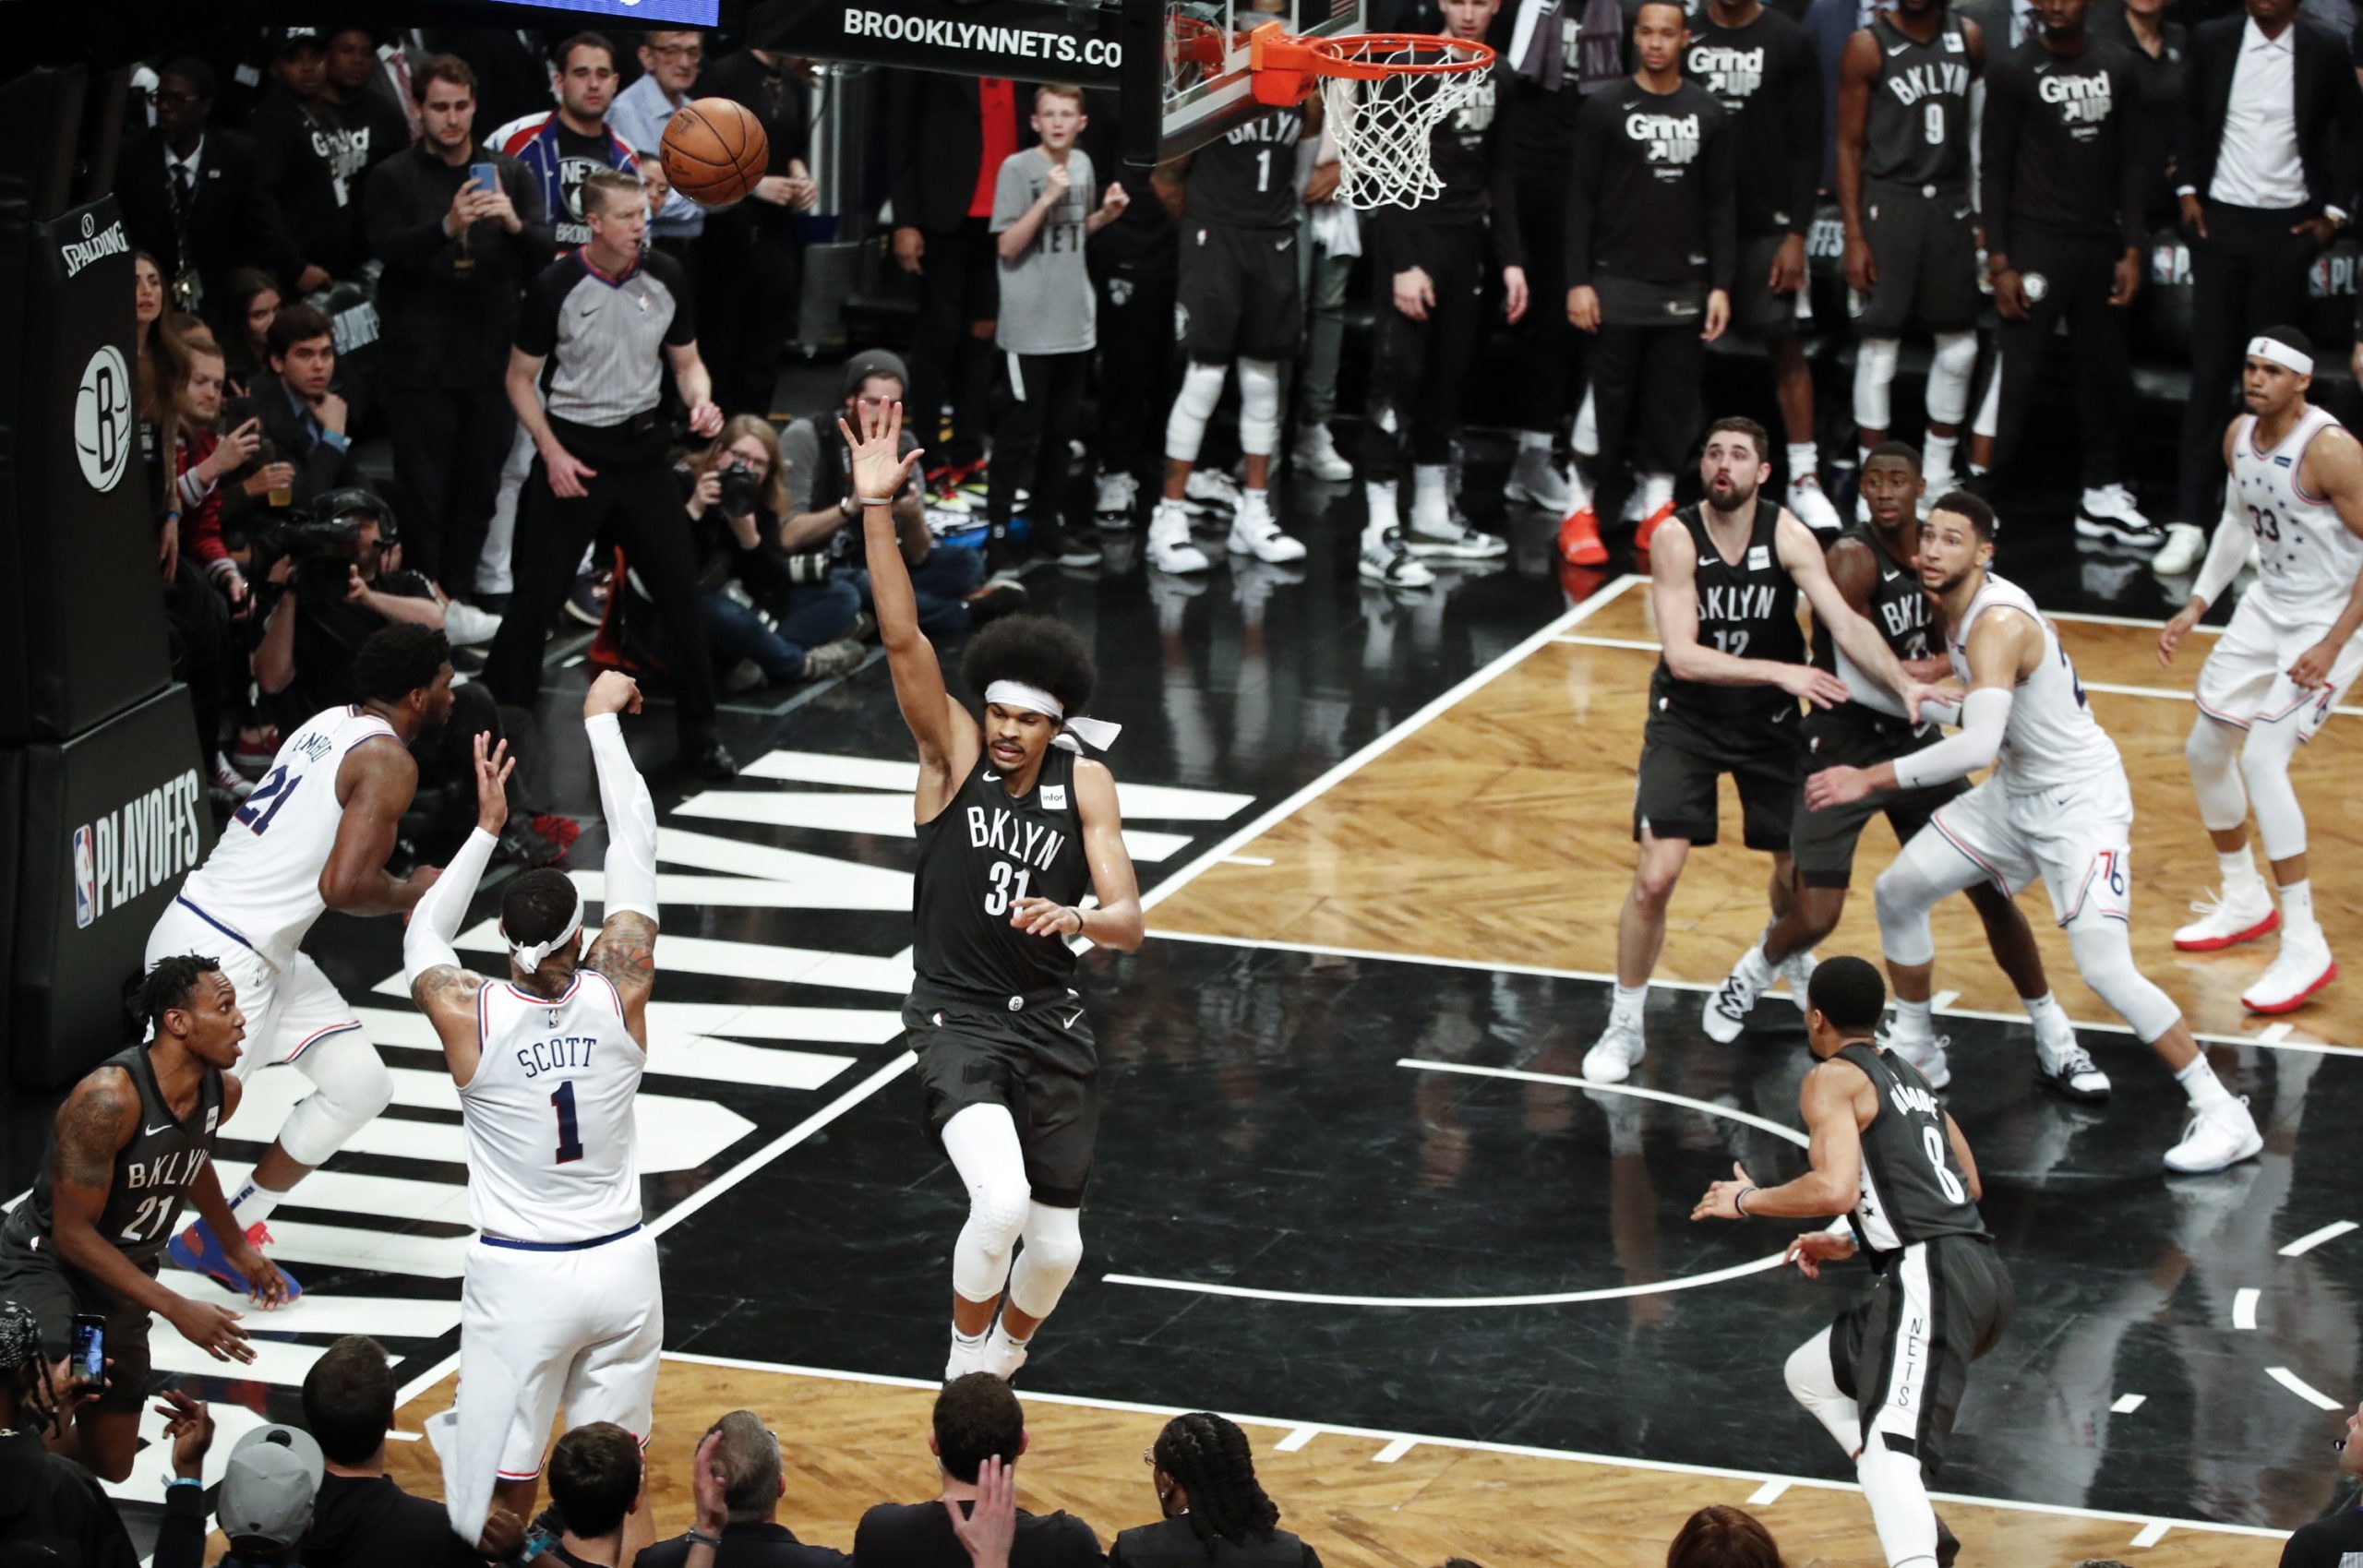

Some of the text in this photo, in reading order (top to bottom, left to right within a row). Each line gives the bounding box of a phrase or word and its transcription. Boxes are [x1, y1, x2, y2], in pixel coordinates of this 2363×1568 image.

[844, 8, 1122, 68] BROOKLYNNETS.CO
[1925, 103, 1944, 144] 9
[1256, 150, 1271, 192] 1
[61, 221, 129, 278] SPALDING
[1881, 592, 1933, 637] BKL
[234, 764, 303, 837] 21
[97, 768, 199, 917] PLAYOFFS
[967, 806, 1065, 871] BKLYN
[984, 861, 1031, 920] 31
[2099, 850, 2124, 896] 76
[517, 1037, 597, 1078] SCOTT
[550, 1081, 583, 1165] 1
[1923, 1126, 1965, 1204] 8
[121, 1196, 175, 1241] 21
[1898, 1317, 1923, 1406] NETS
